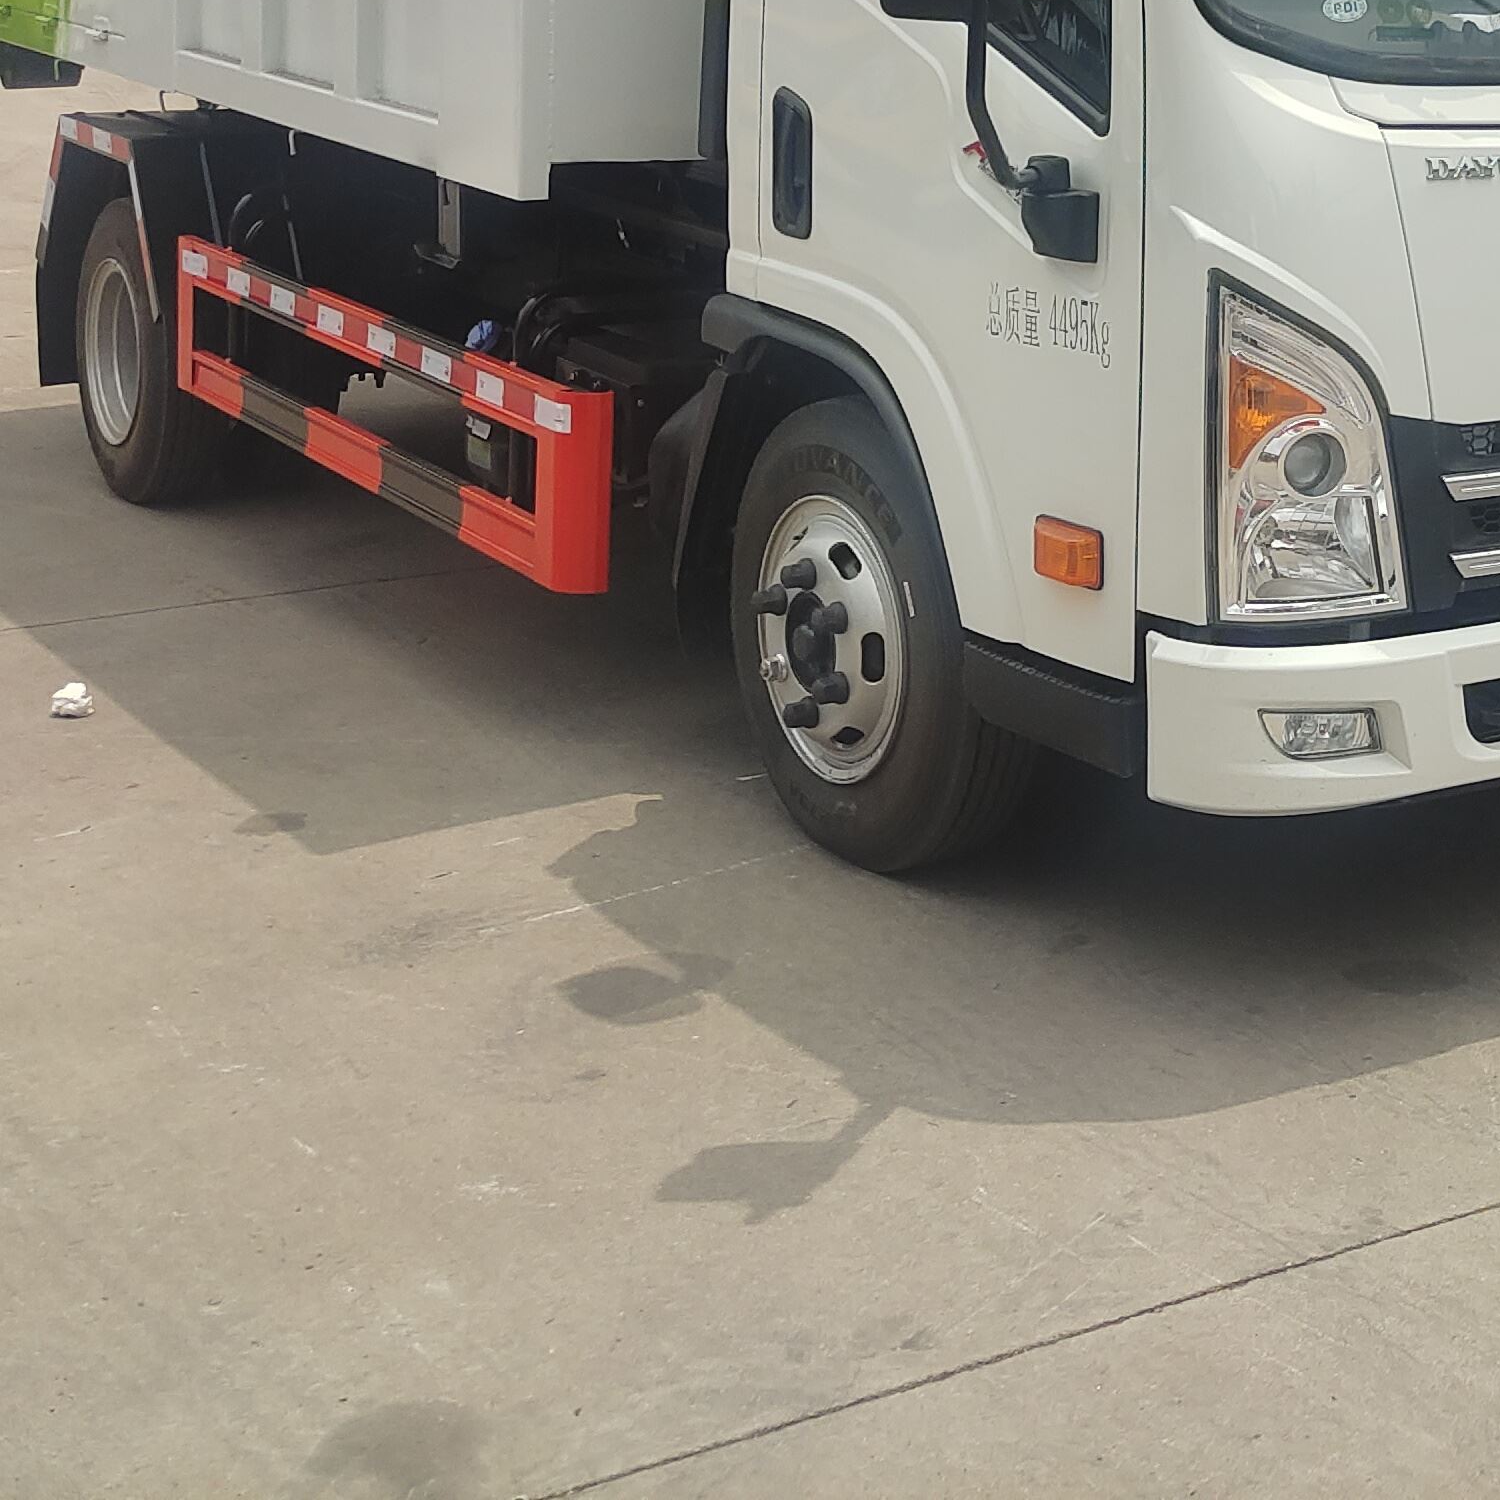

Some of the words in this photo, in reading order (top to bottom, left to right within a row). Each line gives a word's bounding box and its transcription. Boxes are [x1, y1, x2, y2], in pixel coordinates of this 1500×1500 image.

[986, 282, 1041, 348] 总质量
[1049, 293, 1111, 369] 4495Kg
